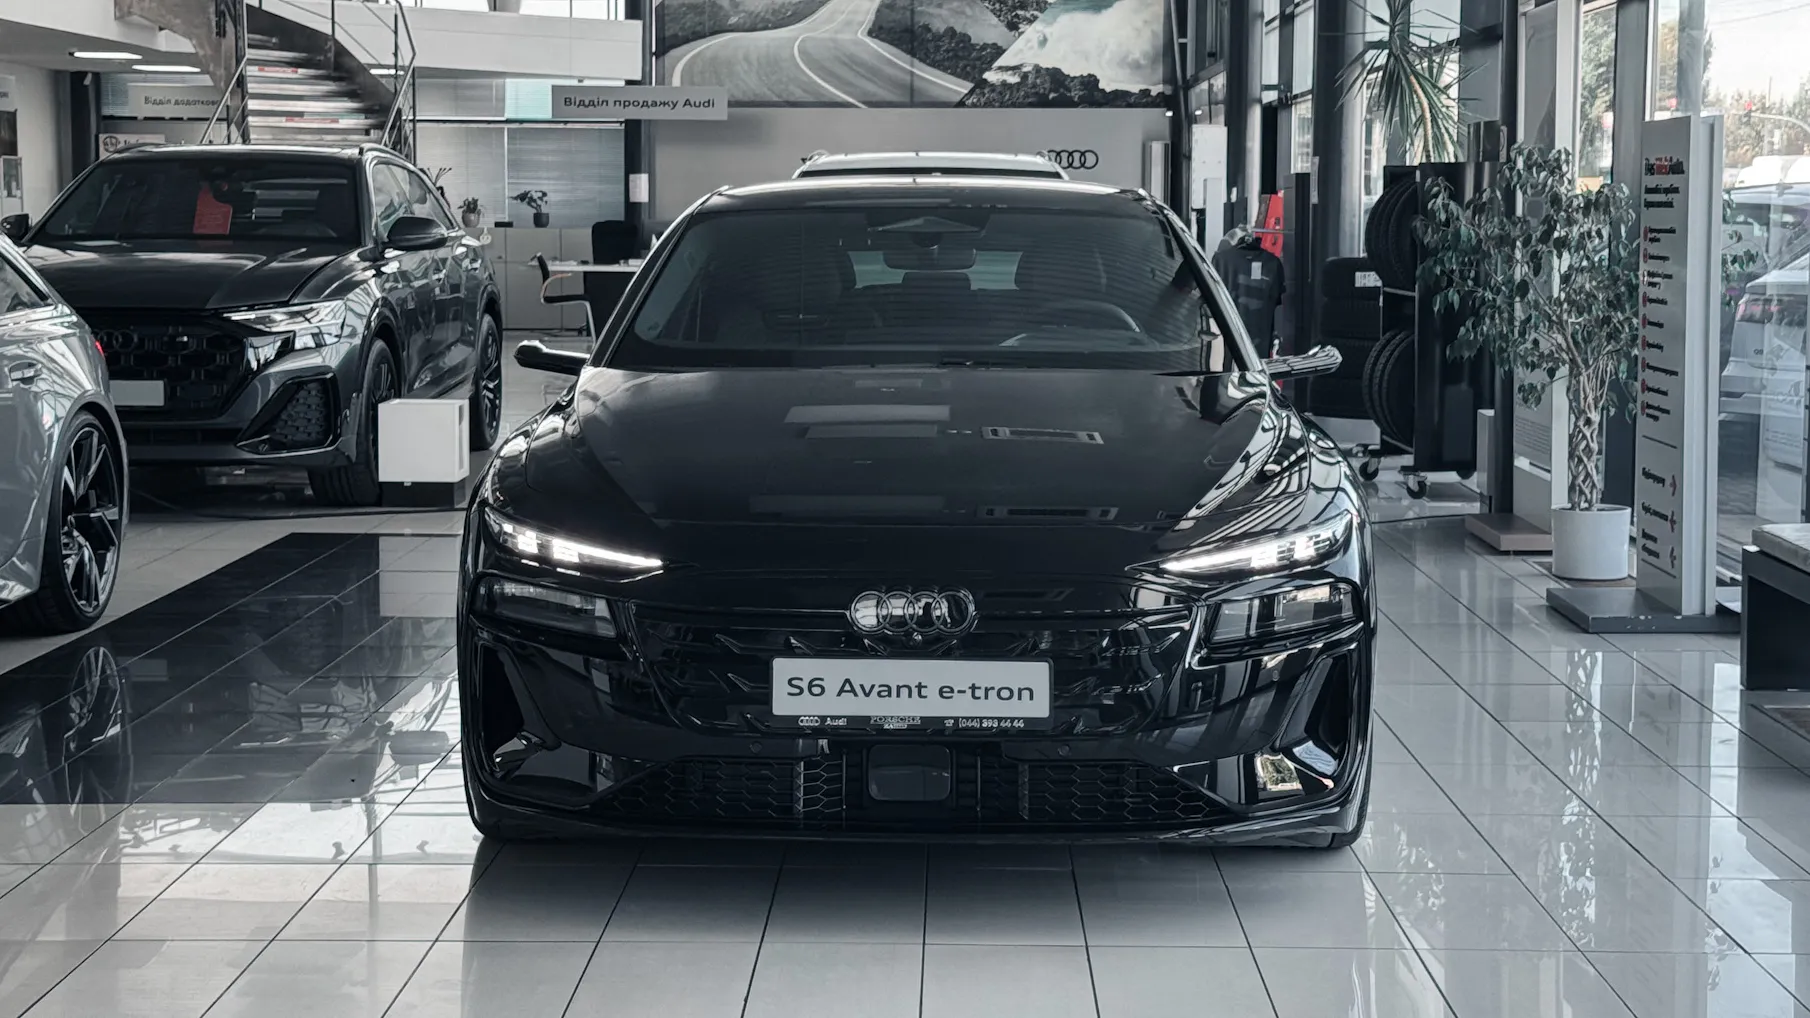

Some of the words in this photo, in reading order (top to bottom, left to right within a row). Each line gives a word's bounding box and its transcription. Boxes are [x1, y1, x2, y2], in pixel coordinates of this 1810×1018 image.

[144, 95, 172, 106] Відділ
[563, 96, 609, 109] Відділ
[613, 98, 679, 110] продажу
[682, 98, 715, 108] Audi
[787, 676, 826, 697] S6
[836, 678, 928, 699] Avant
[938, 682, 1035, 702] e-tron
[824, 717, 847, 726] Audi
[870, 716, 921, 725] PORSCHE
[958, 717, 980, 728] (044)
